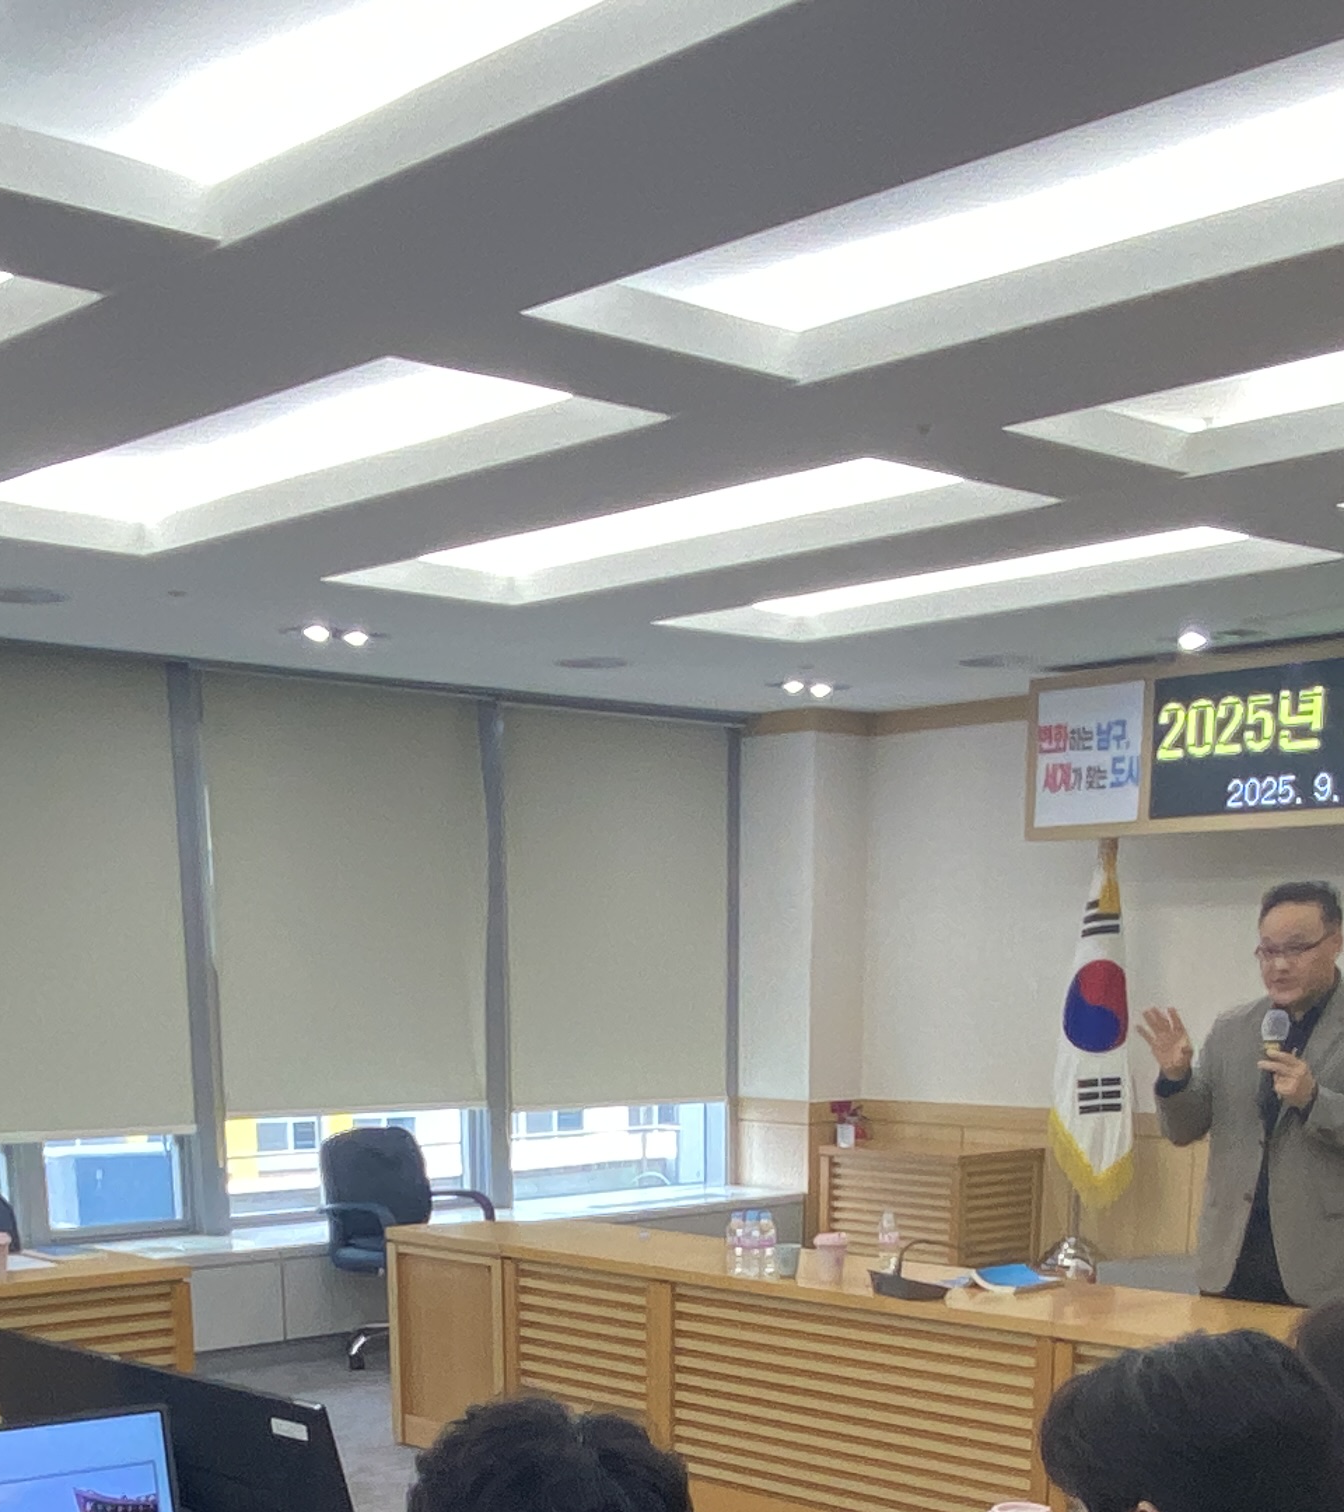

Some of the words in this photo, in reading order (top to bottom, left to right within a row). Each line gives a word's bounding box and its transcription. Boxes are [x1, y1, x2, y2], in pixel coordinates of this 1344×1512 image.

[1156, 685, 1325, 762] 2025년
[1226, 774, 1302, 808] 2025.
[1313, 770, 1339, 802] 9.
